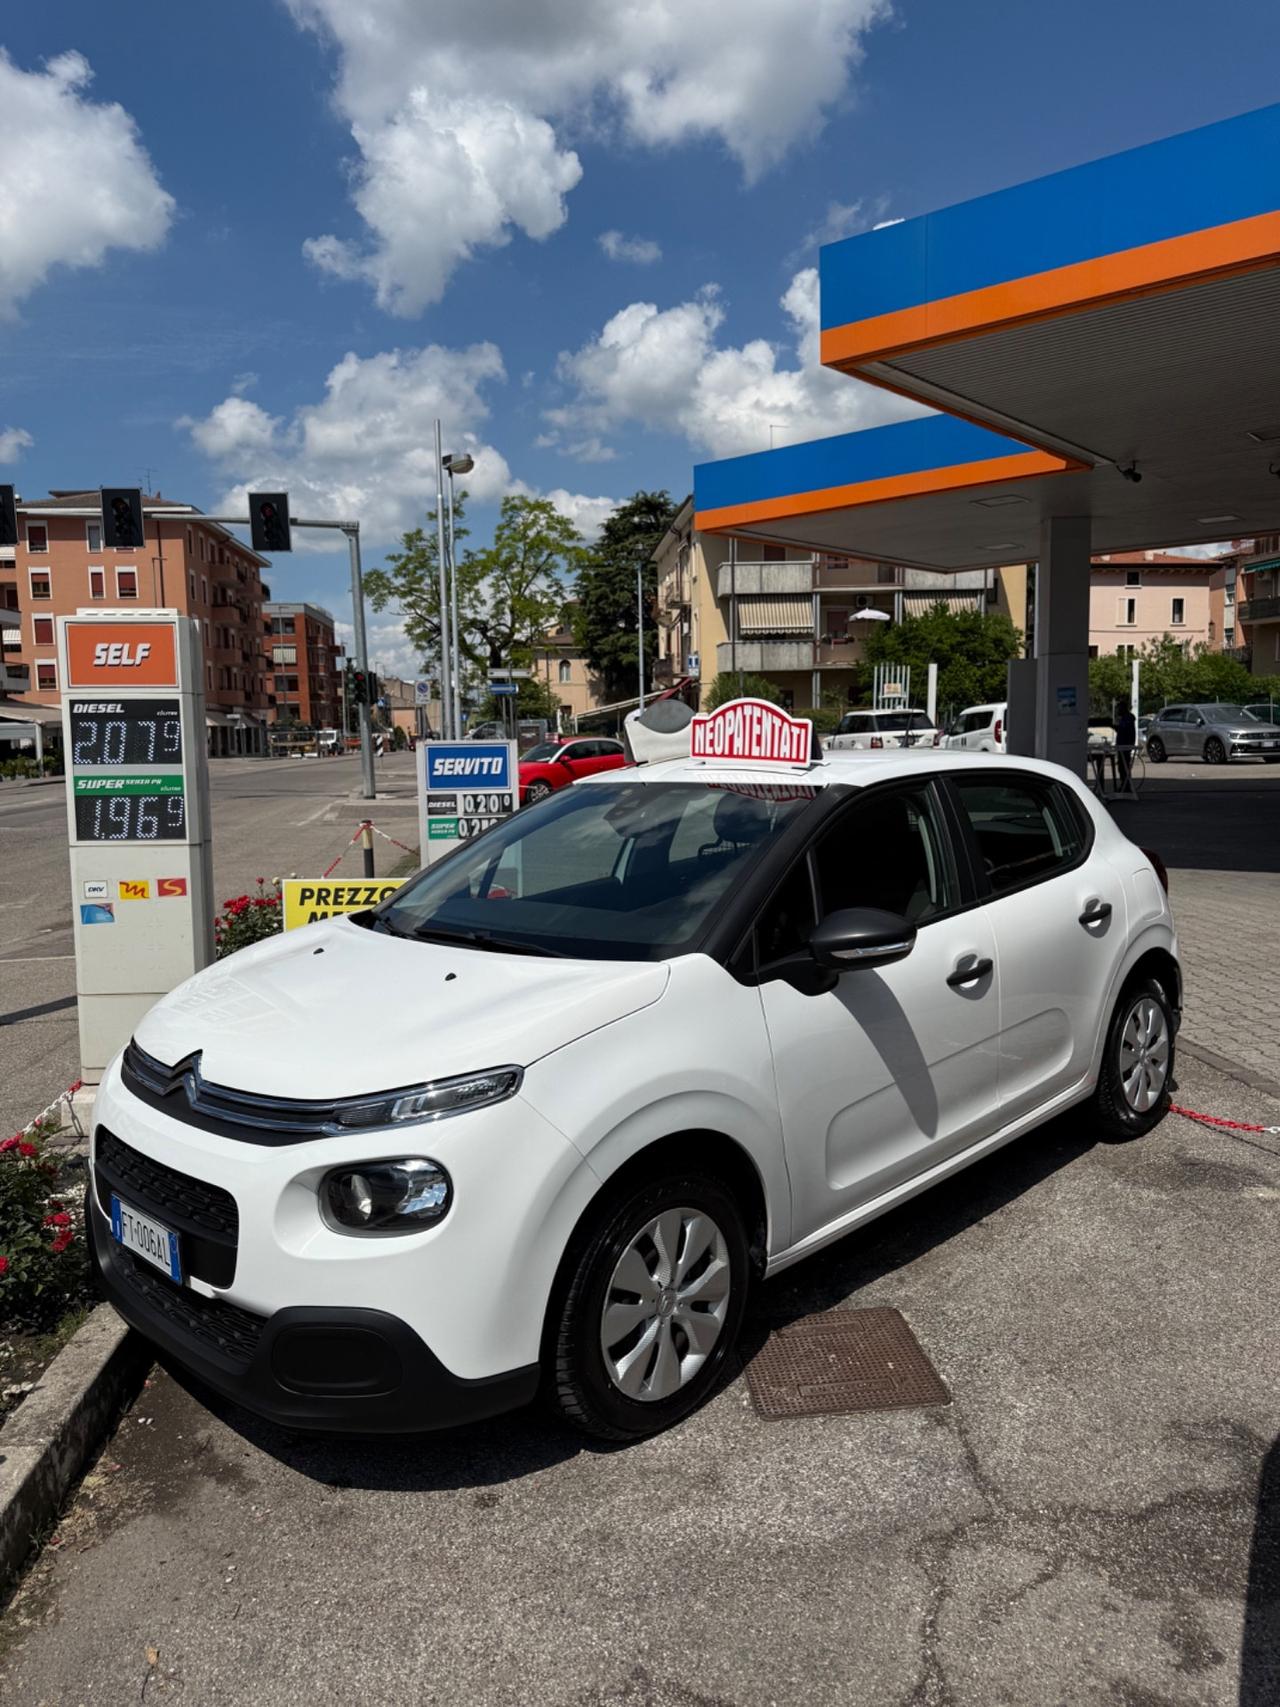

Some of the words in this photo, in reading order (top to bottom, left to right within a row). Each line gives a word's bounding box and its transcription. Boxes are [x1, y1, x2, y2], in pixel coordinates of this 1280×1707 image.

[93, 643, 151, 667] SELF
[72, 703, 125, 714] DIESEL
[694, 704, 806, 760] NEOPATENTATI
[432, 757, 504, 776] SERVITO
[76, 779, 125, 789] SUPER
